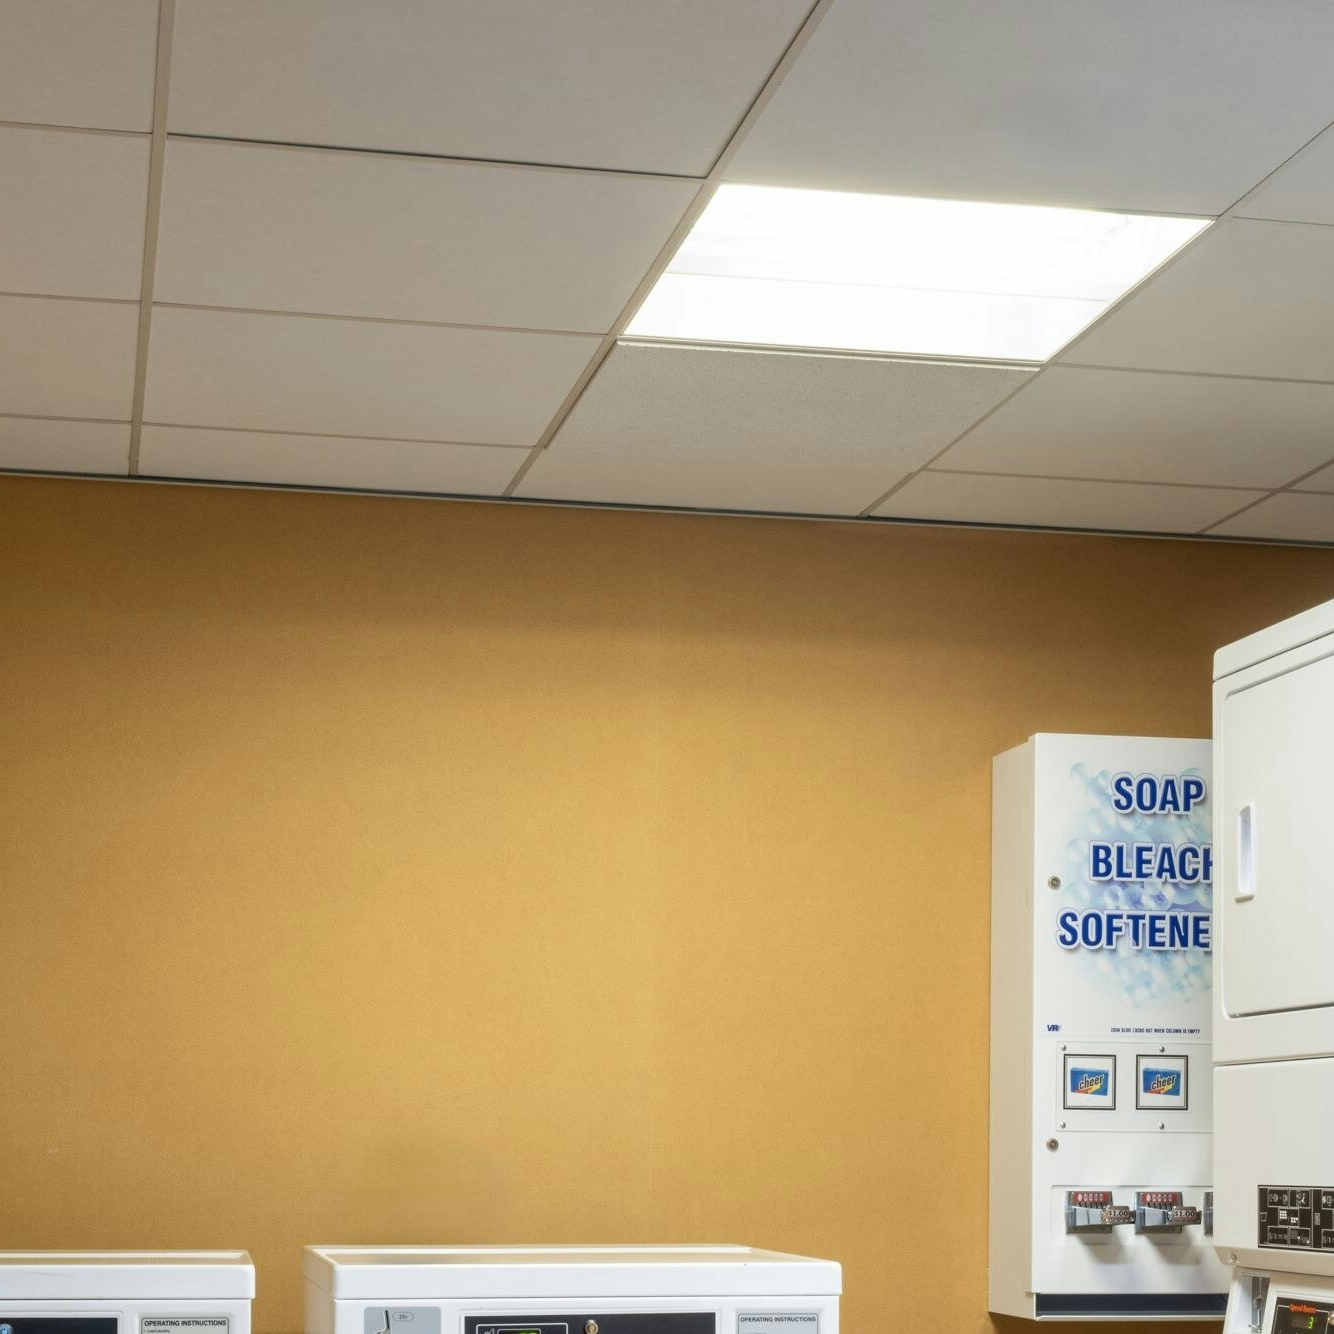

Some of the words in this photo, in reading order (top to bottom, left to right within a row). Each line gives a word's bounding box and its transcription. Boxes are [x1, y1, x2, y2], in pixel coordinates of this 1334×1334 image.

[1113, 776, 1204, 812] SOAP
[1058, 911, 1211, 949] SOFTENE
[1079, 1074, 1104, 1090] cheer
[1151, 1074, 1176, 1090] cheer
